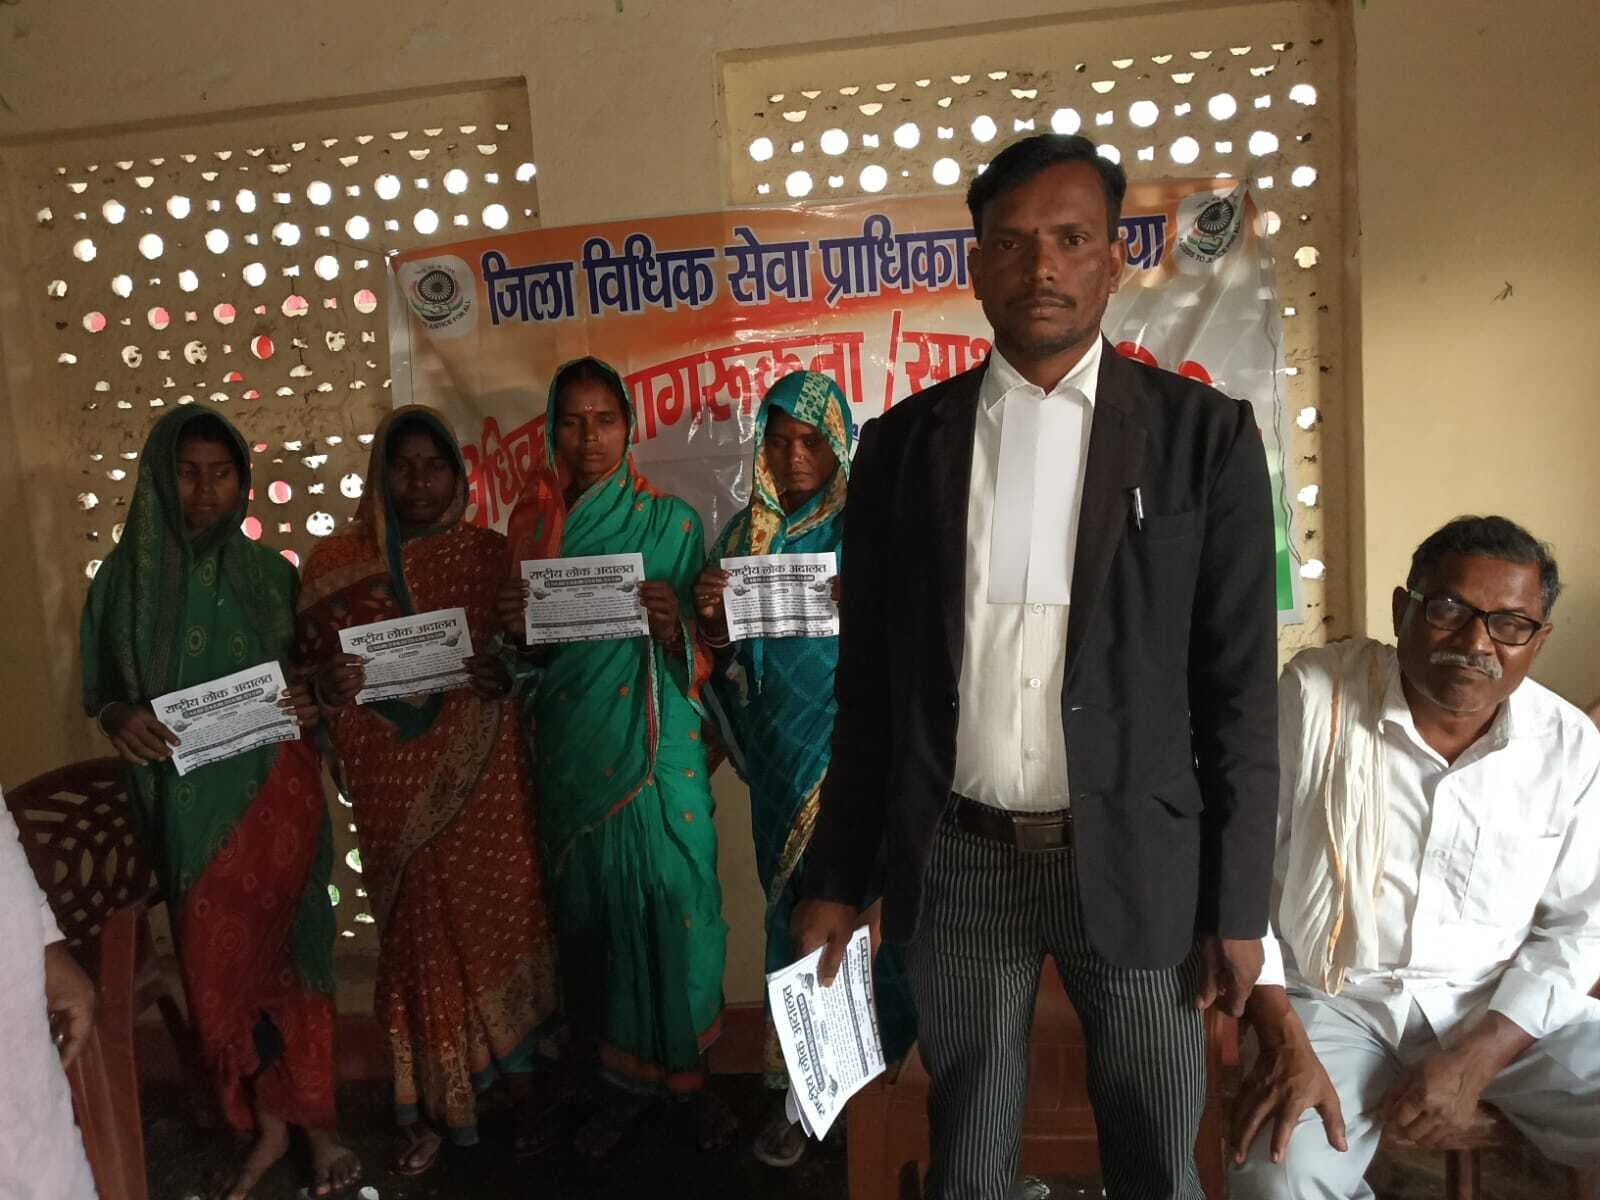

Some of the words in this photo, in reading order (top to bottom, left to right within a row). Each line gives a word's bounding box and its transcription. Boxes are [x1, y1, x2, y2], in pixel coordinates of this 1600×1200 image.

[481, 251, 575, 325] जिला
[583, 234, 716, 314] विधिक
[724, 228, 810, 302] सेवा
[819, 214, 977, 305] प्राधिका
[624, 332, 865, 444] ागरूकता
